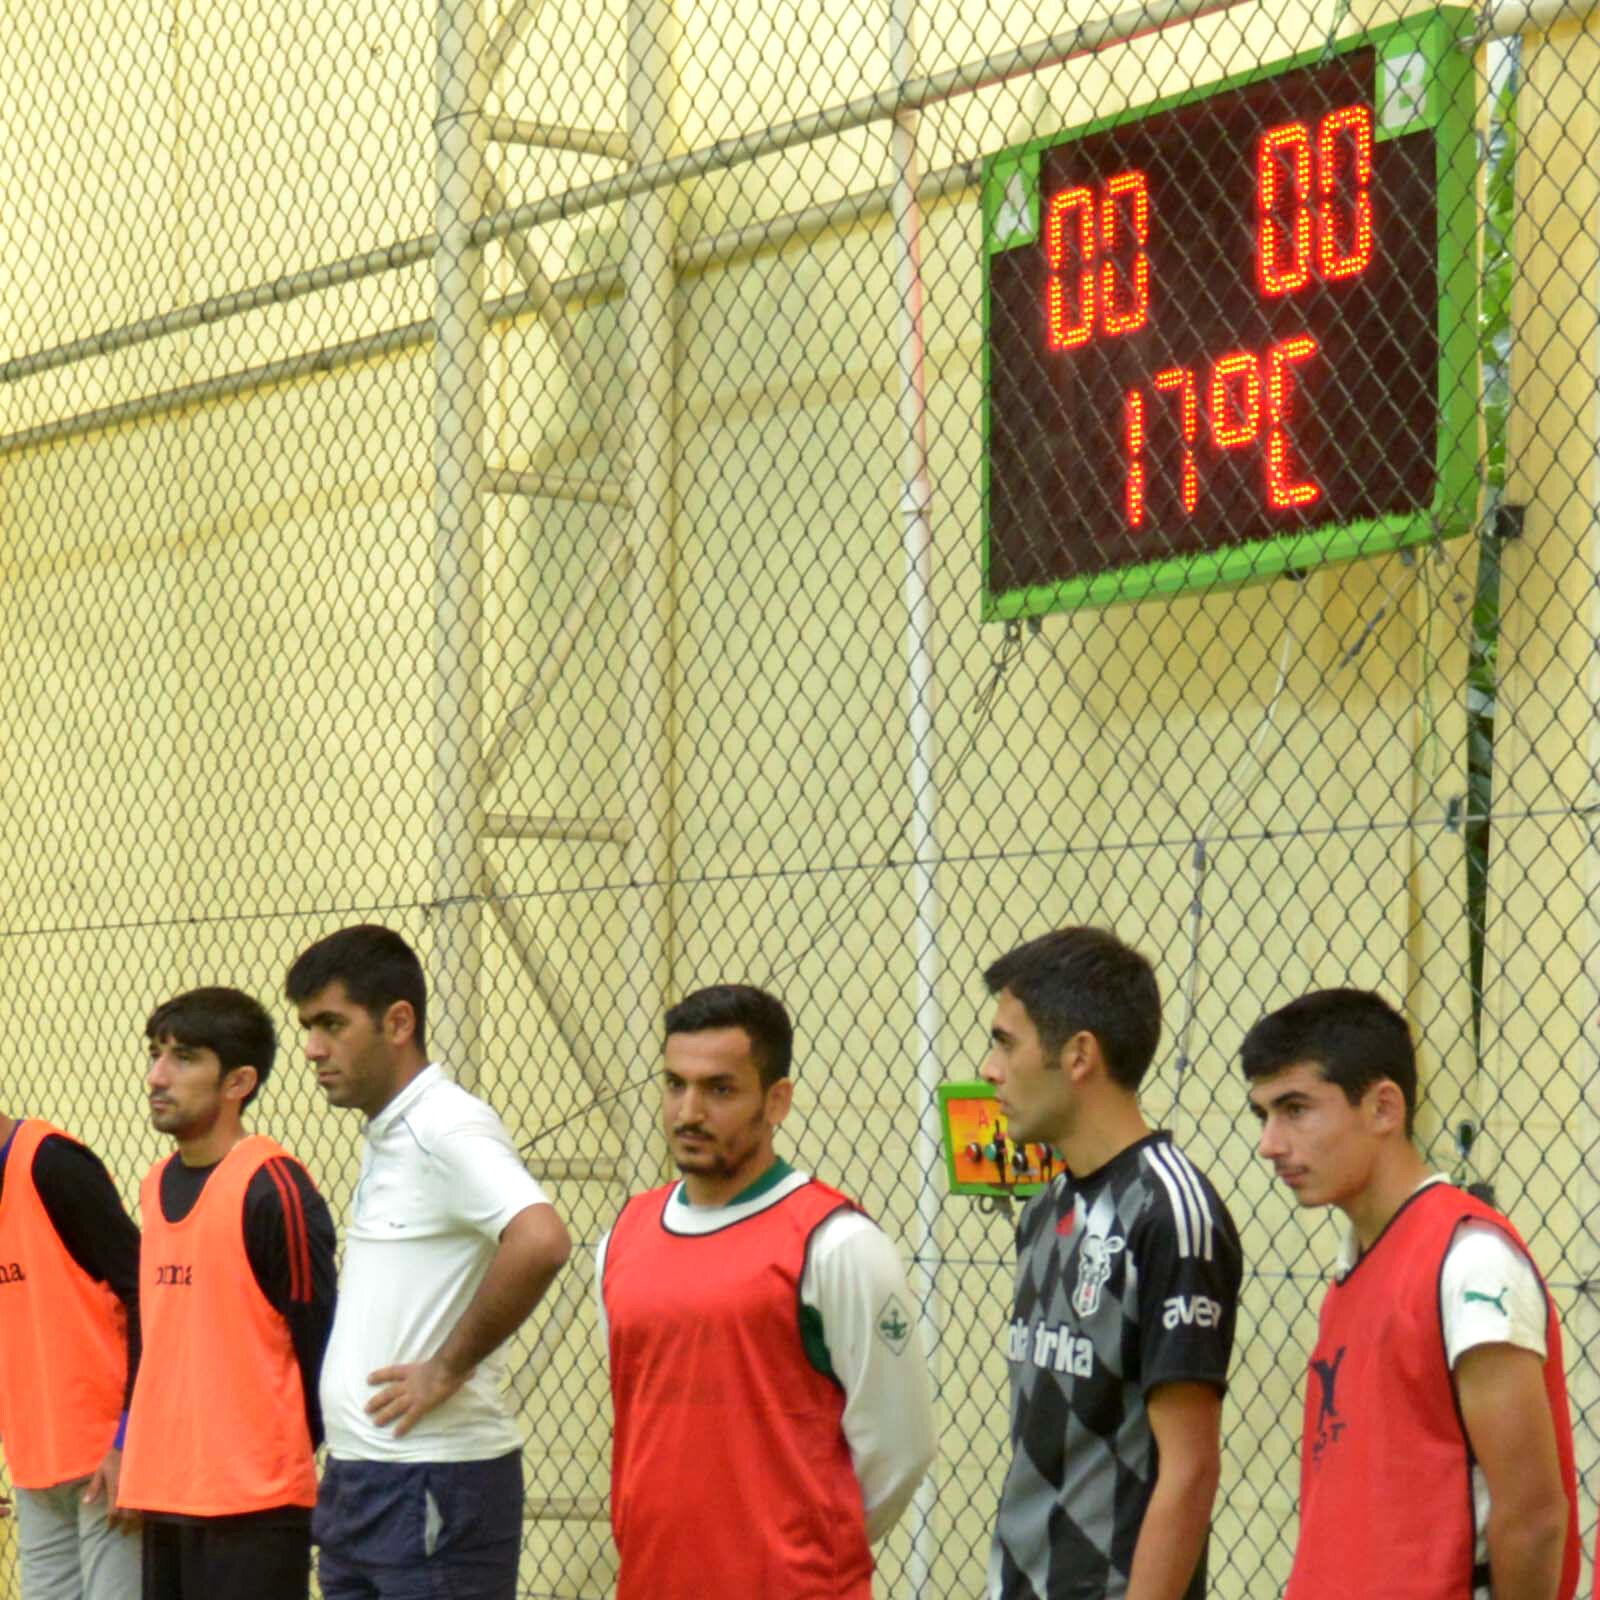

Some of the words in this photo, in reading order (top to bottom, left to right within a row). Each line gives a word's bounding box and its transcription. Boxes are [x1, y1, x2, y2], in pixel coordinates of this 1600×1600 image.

[1383, 52, 1426, 128] B
[994, 172, 1032, 243] A
[1047, 171, 1148, 349] 00
[1256, 105, 1370, 295] 00
